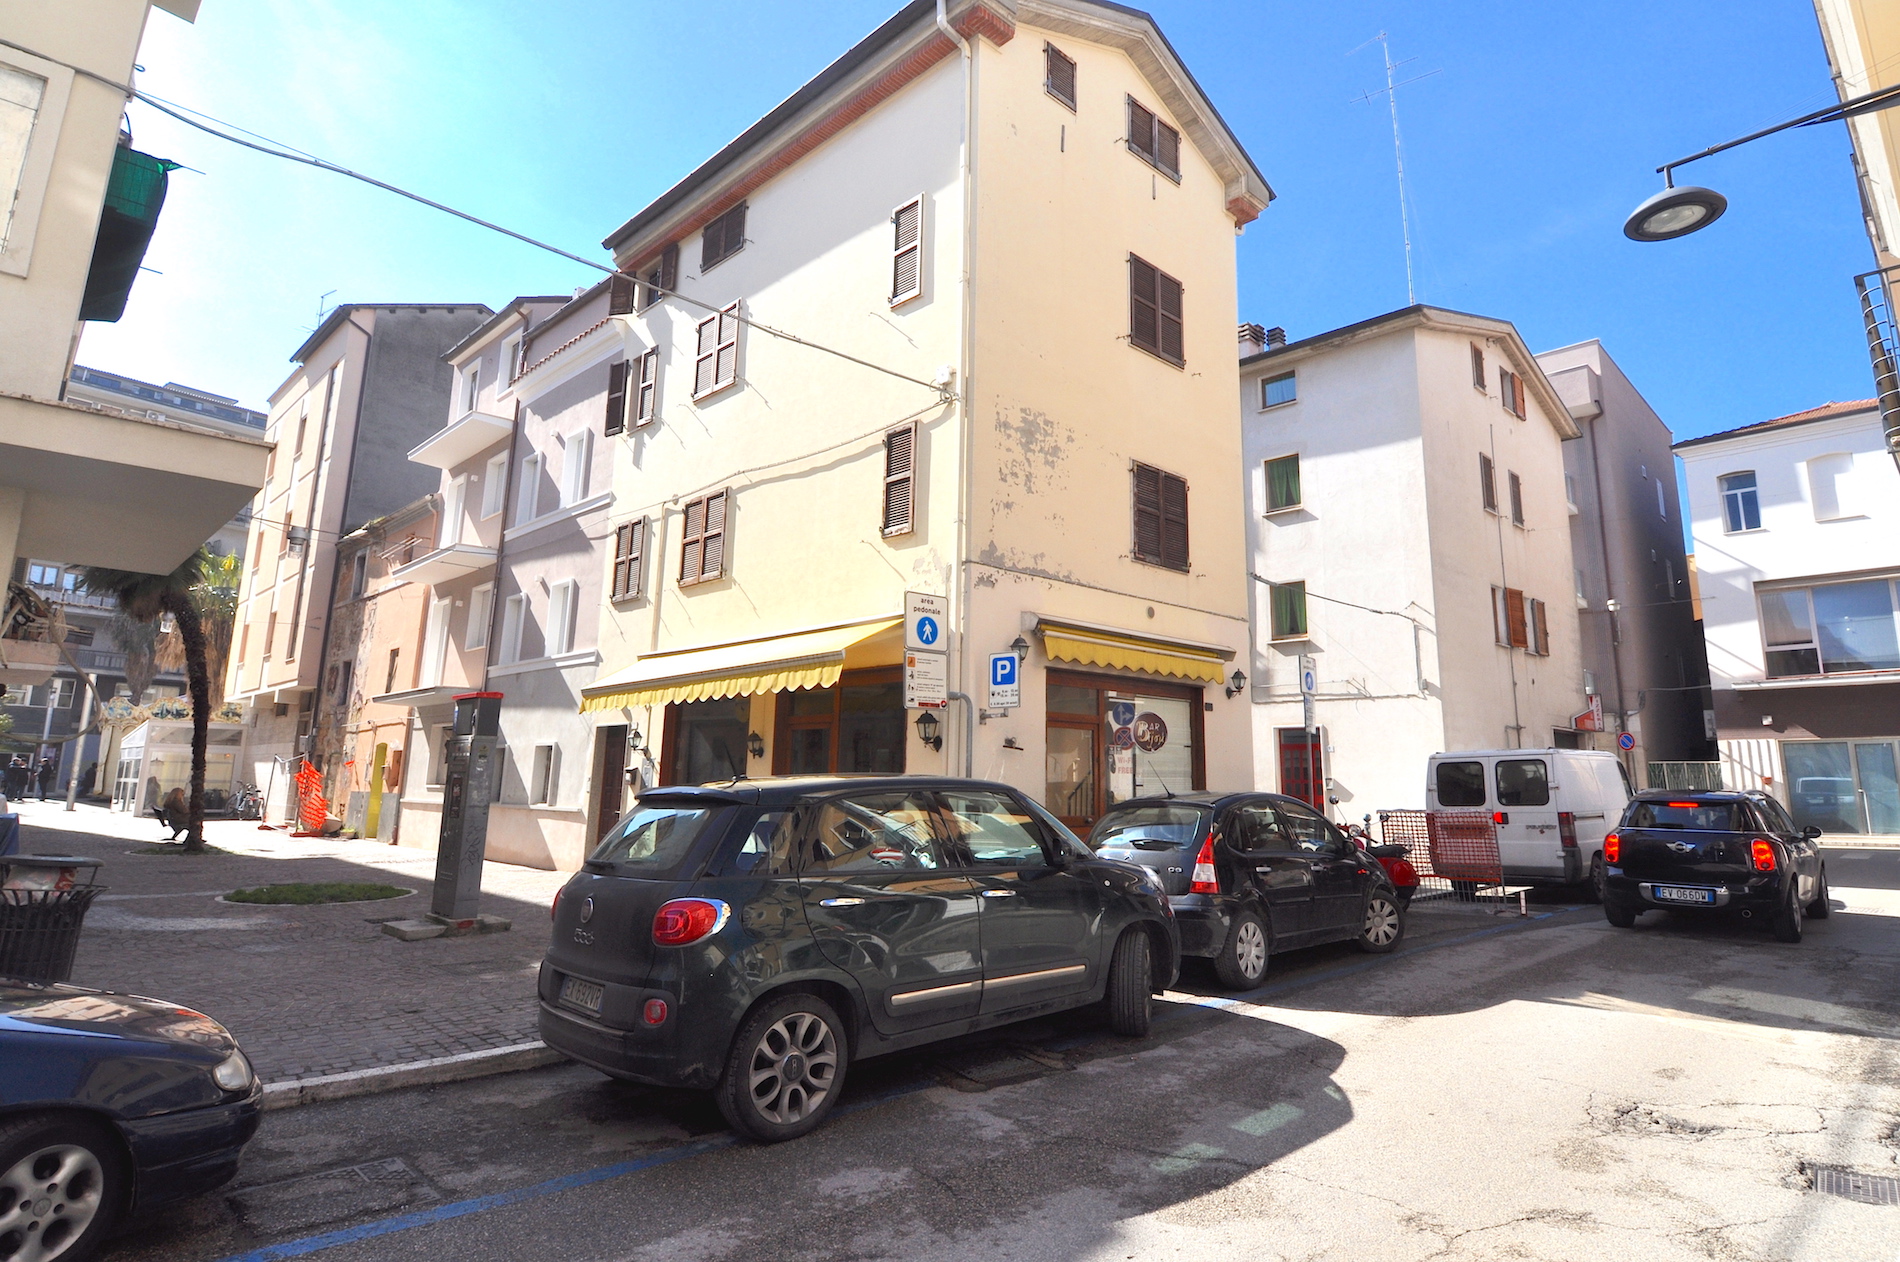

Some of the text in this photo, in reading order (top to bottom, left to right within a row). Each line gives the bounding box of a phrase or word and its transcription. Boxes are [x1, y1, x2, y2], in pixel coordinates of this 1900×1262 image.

[920, 597, 934, 605] area
[913, 606, 941, 615] pedonale
[996, 660, 1011, 682] P
[1661, 888, 1707, 901] EV 066DW
